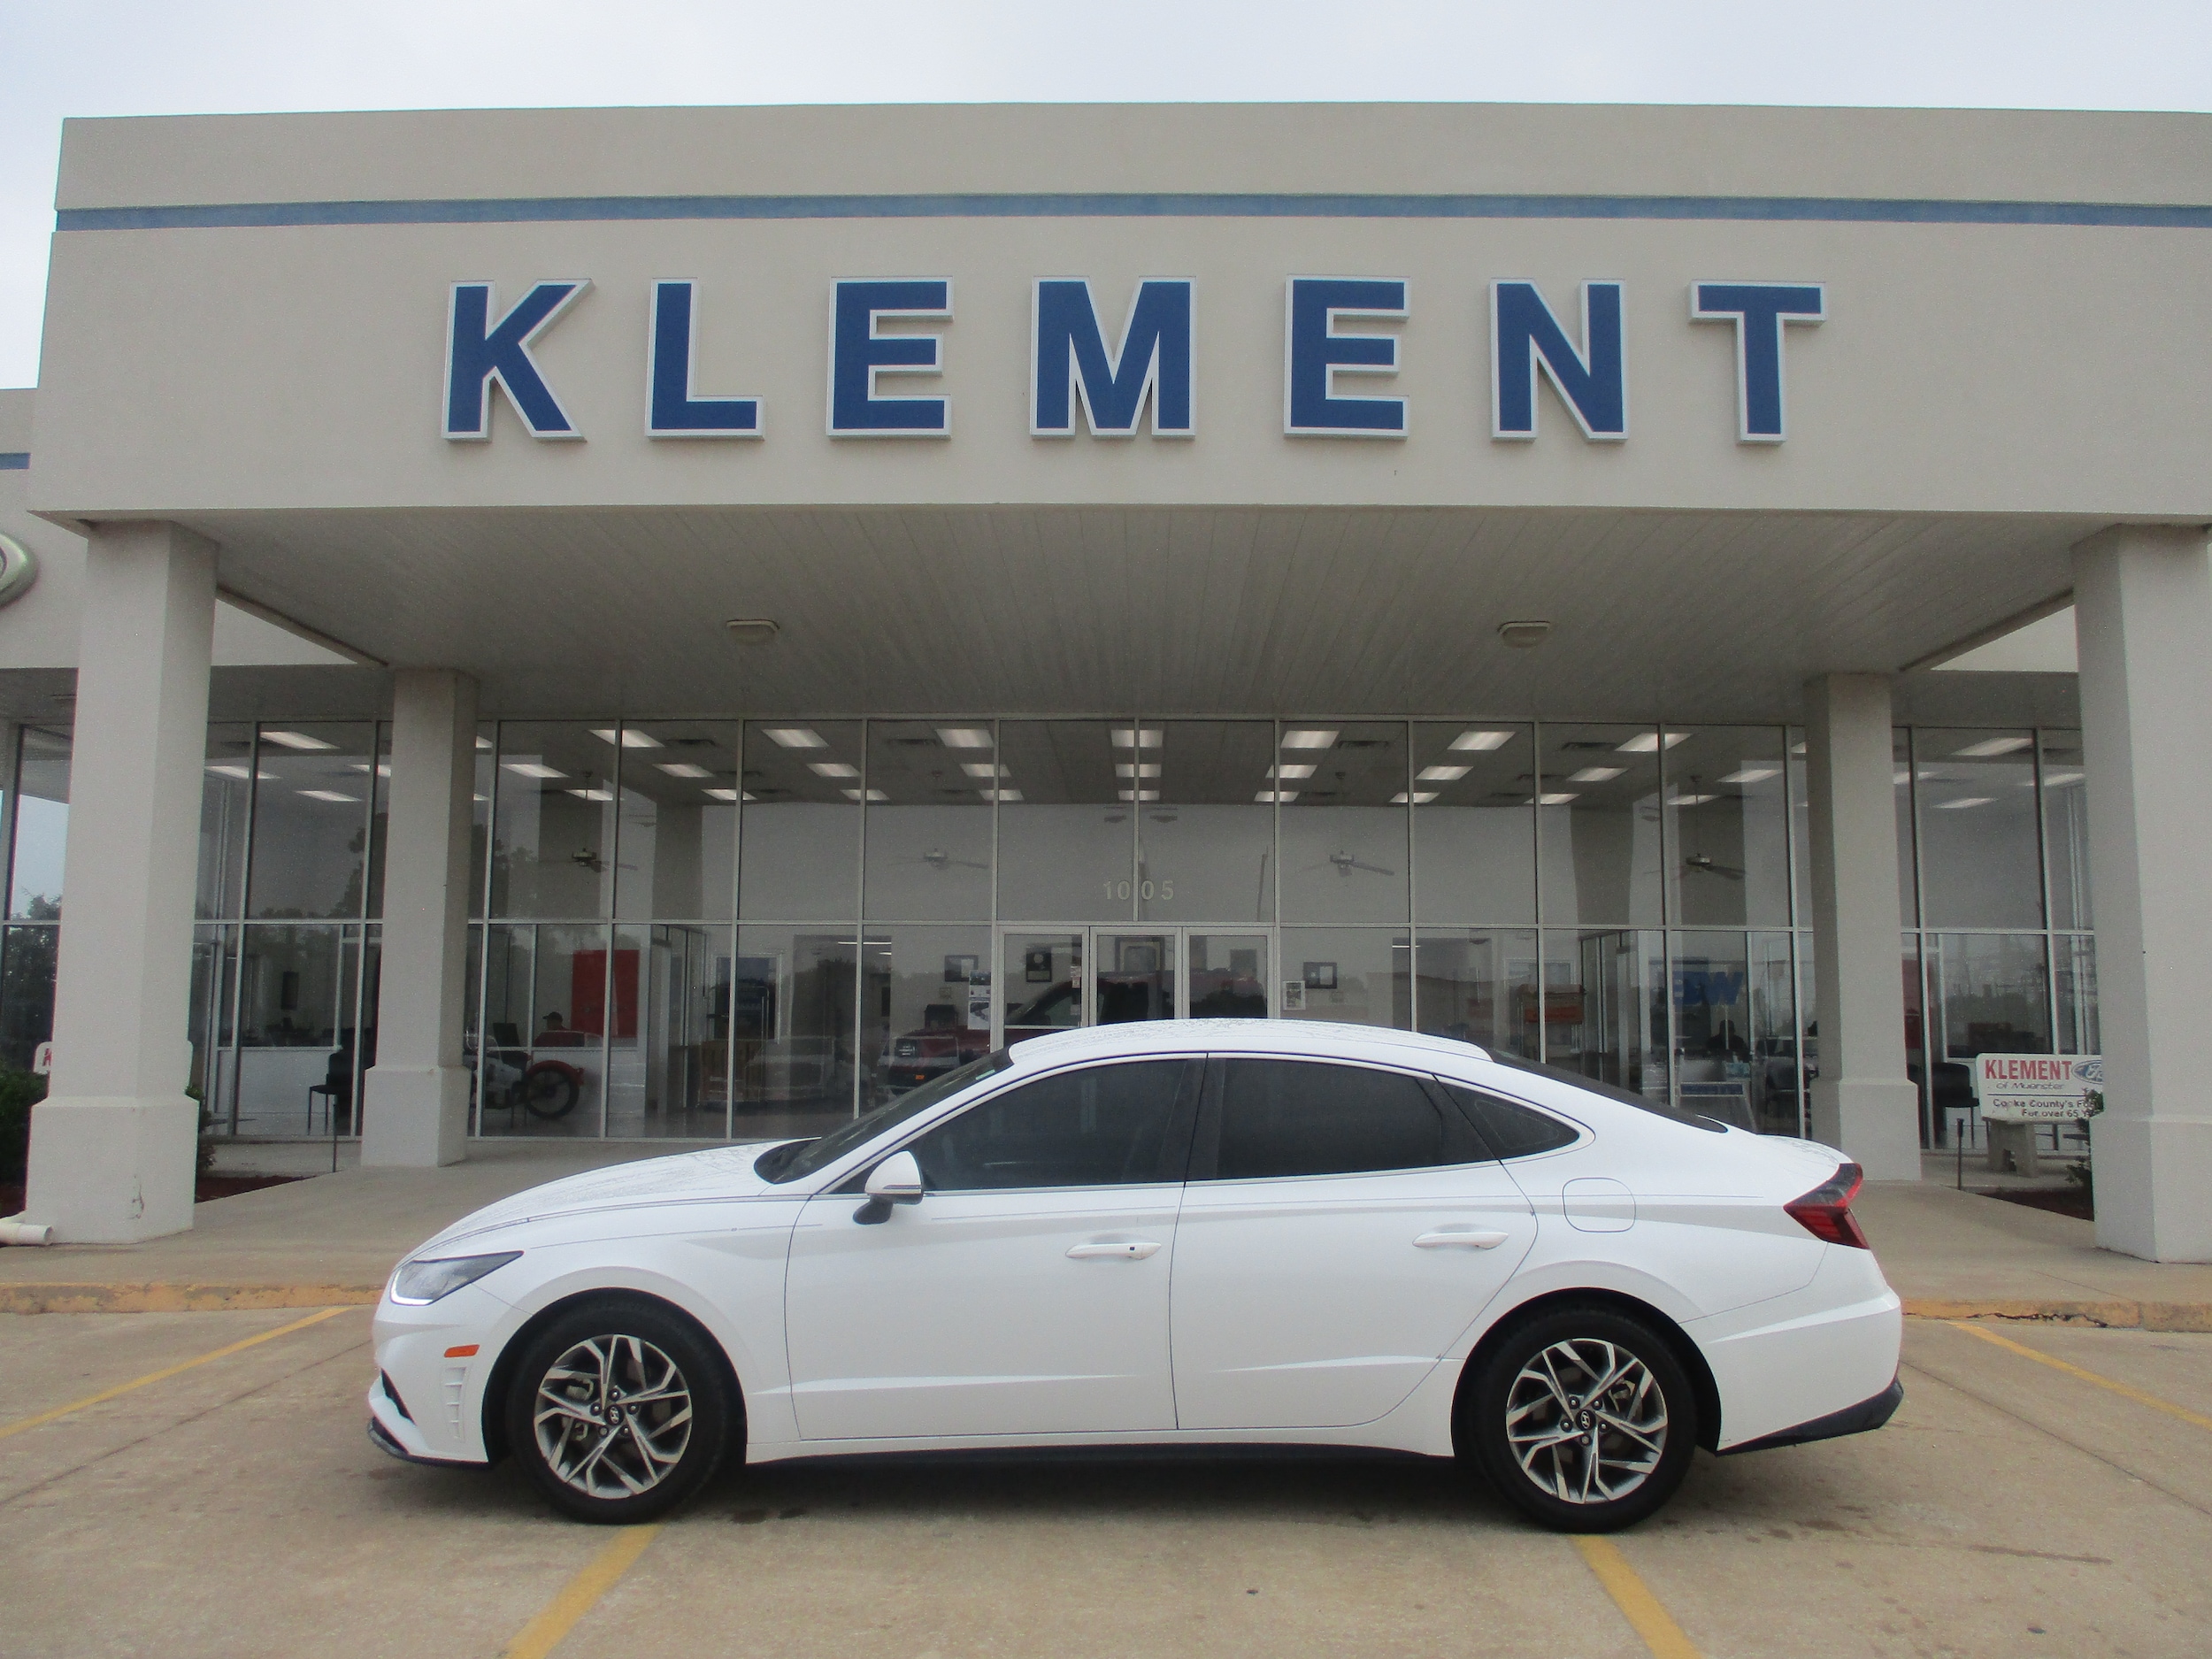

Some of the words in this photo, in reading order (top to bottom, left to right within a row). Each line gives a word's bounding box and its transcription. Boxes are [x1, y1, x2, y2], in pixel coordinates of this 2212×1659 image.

[442, 277, 1826, 443] KLEMENT
[1103, 879, 1174, 900] 1005
[1985, 1059, 2072, 1080] KLEMENT
[1993, 1099, 2025, 1108] Coke
